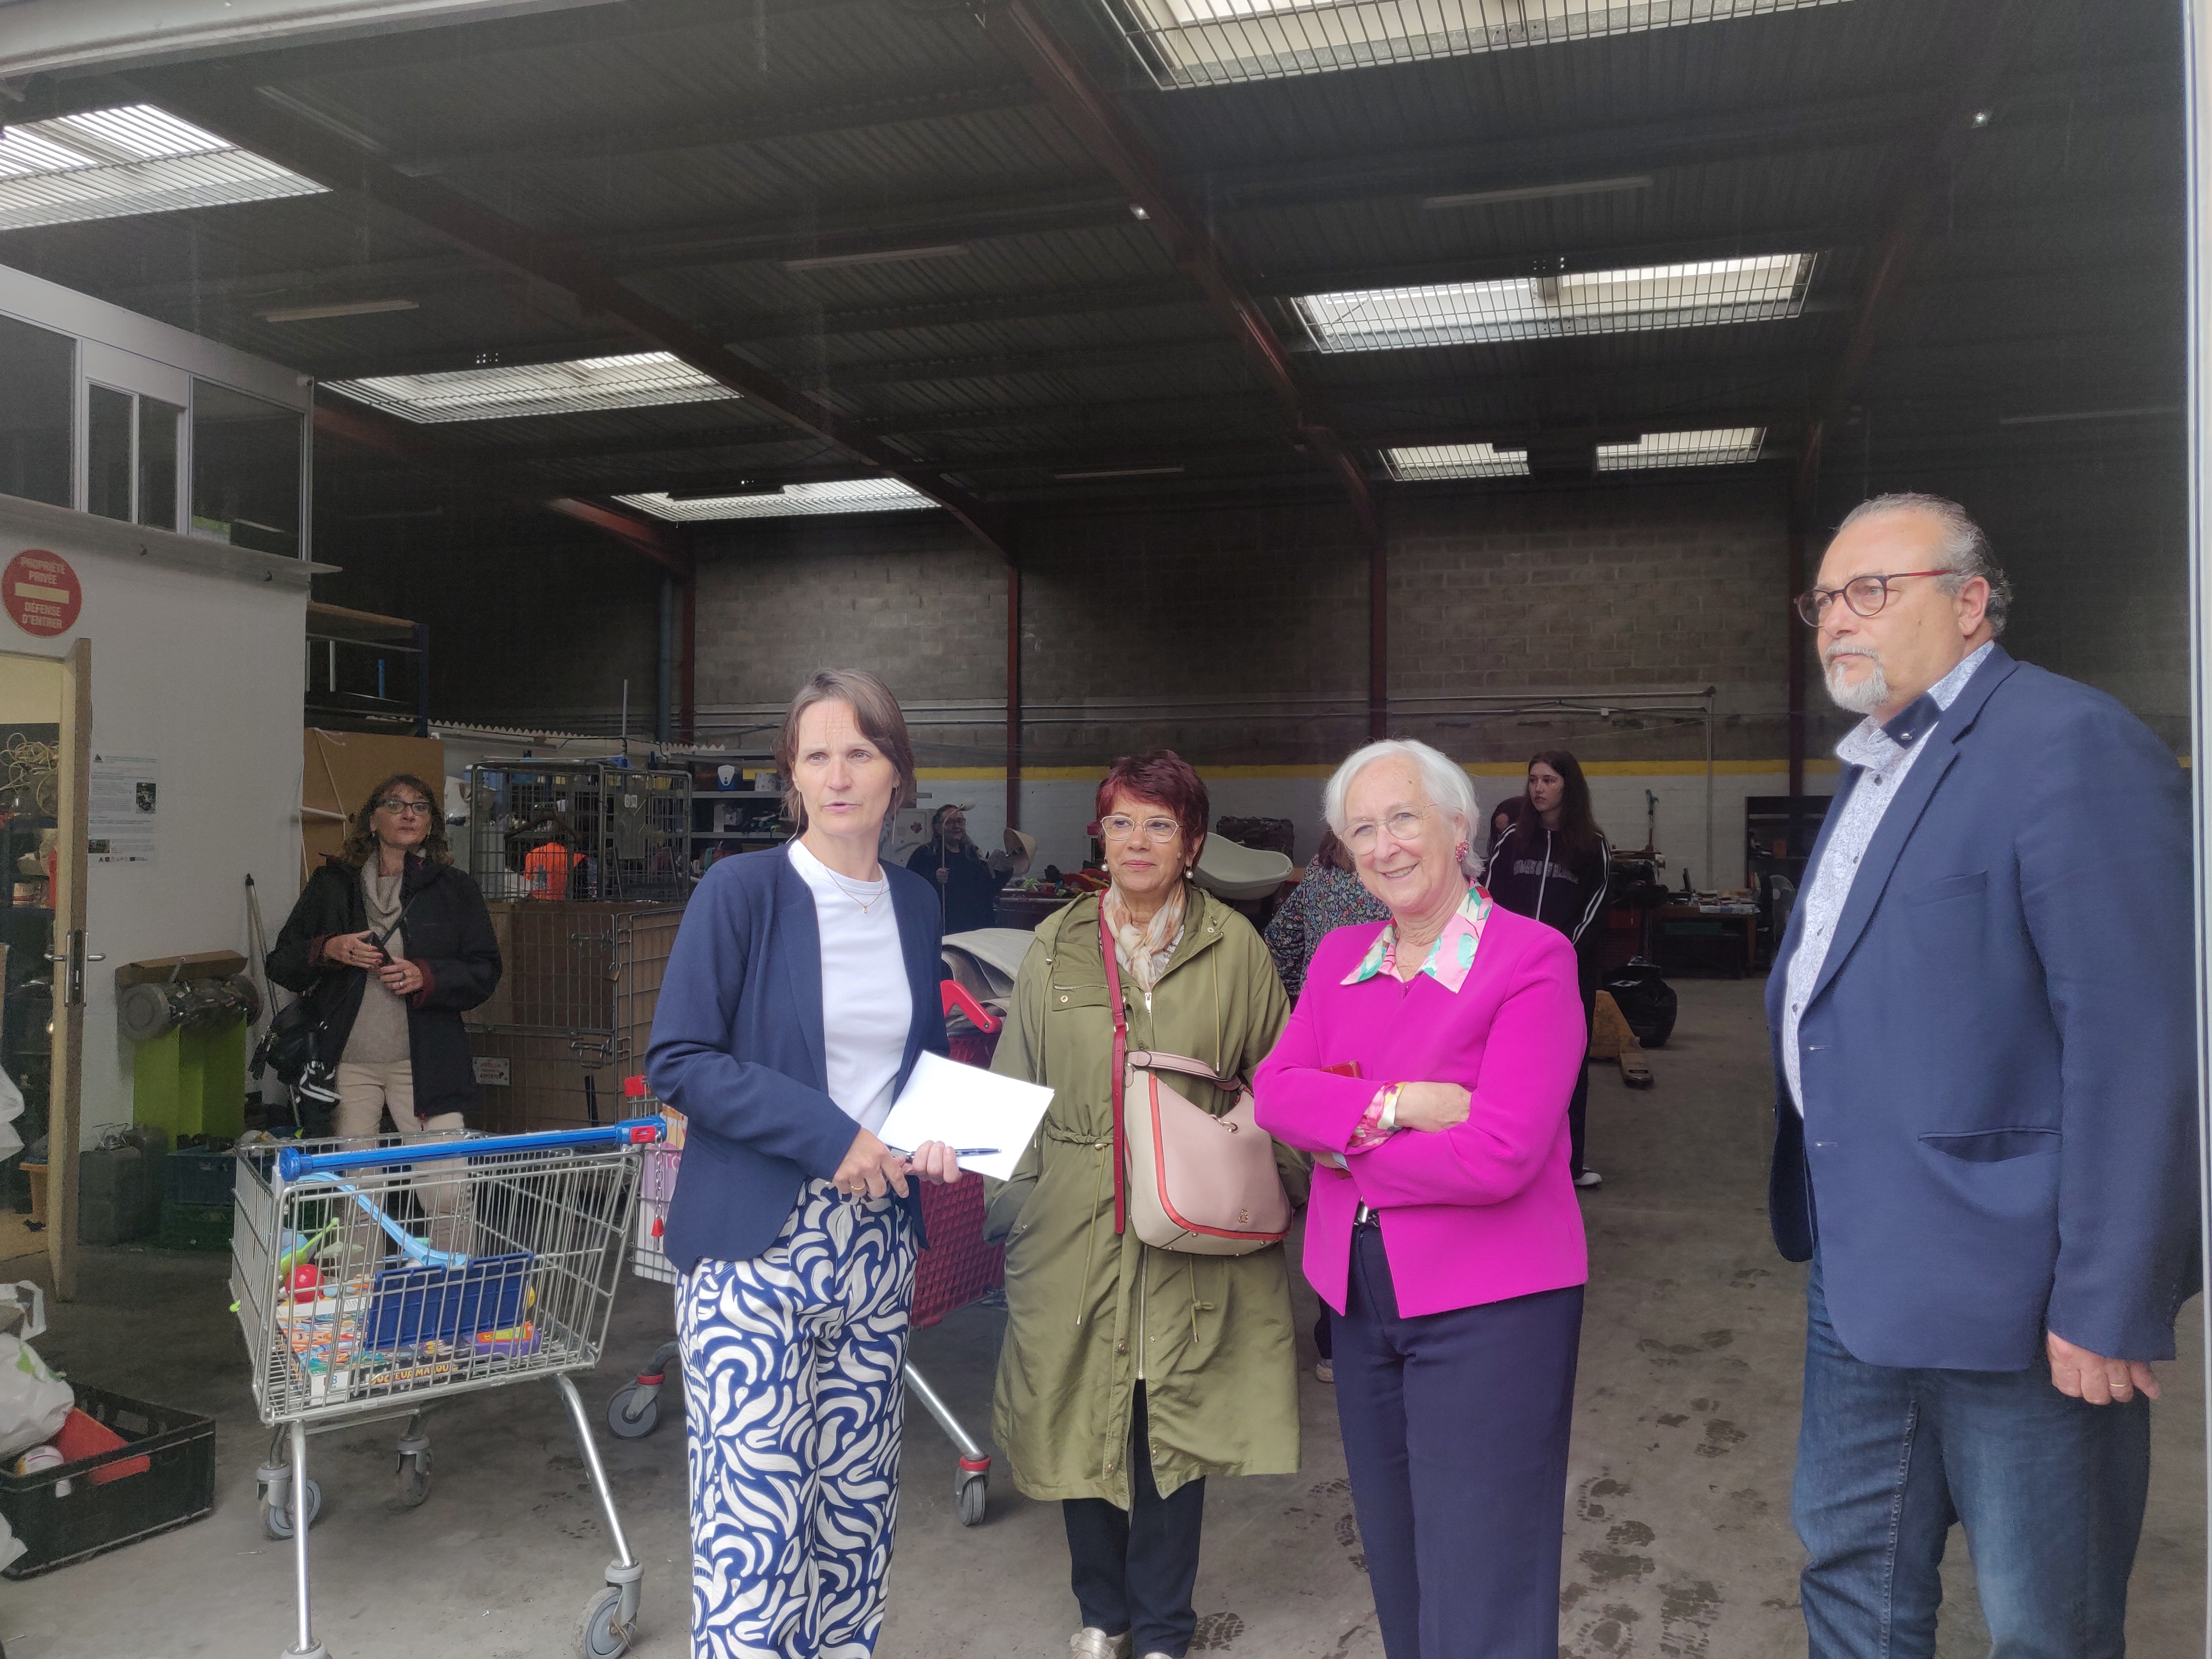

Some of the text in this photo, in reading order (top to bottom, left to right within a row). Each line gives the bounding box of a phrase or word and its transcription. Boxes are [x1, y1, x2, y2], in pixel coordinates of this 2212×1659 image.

[24, 600, 61, 616] DÉFENSE
[22, 614, 62, 629] D'ENTRER
[366, 1363, 458, 1385] OCEUR MAOUL
